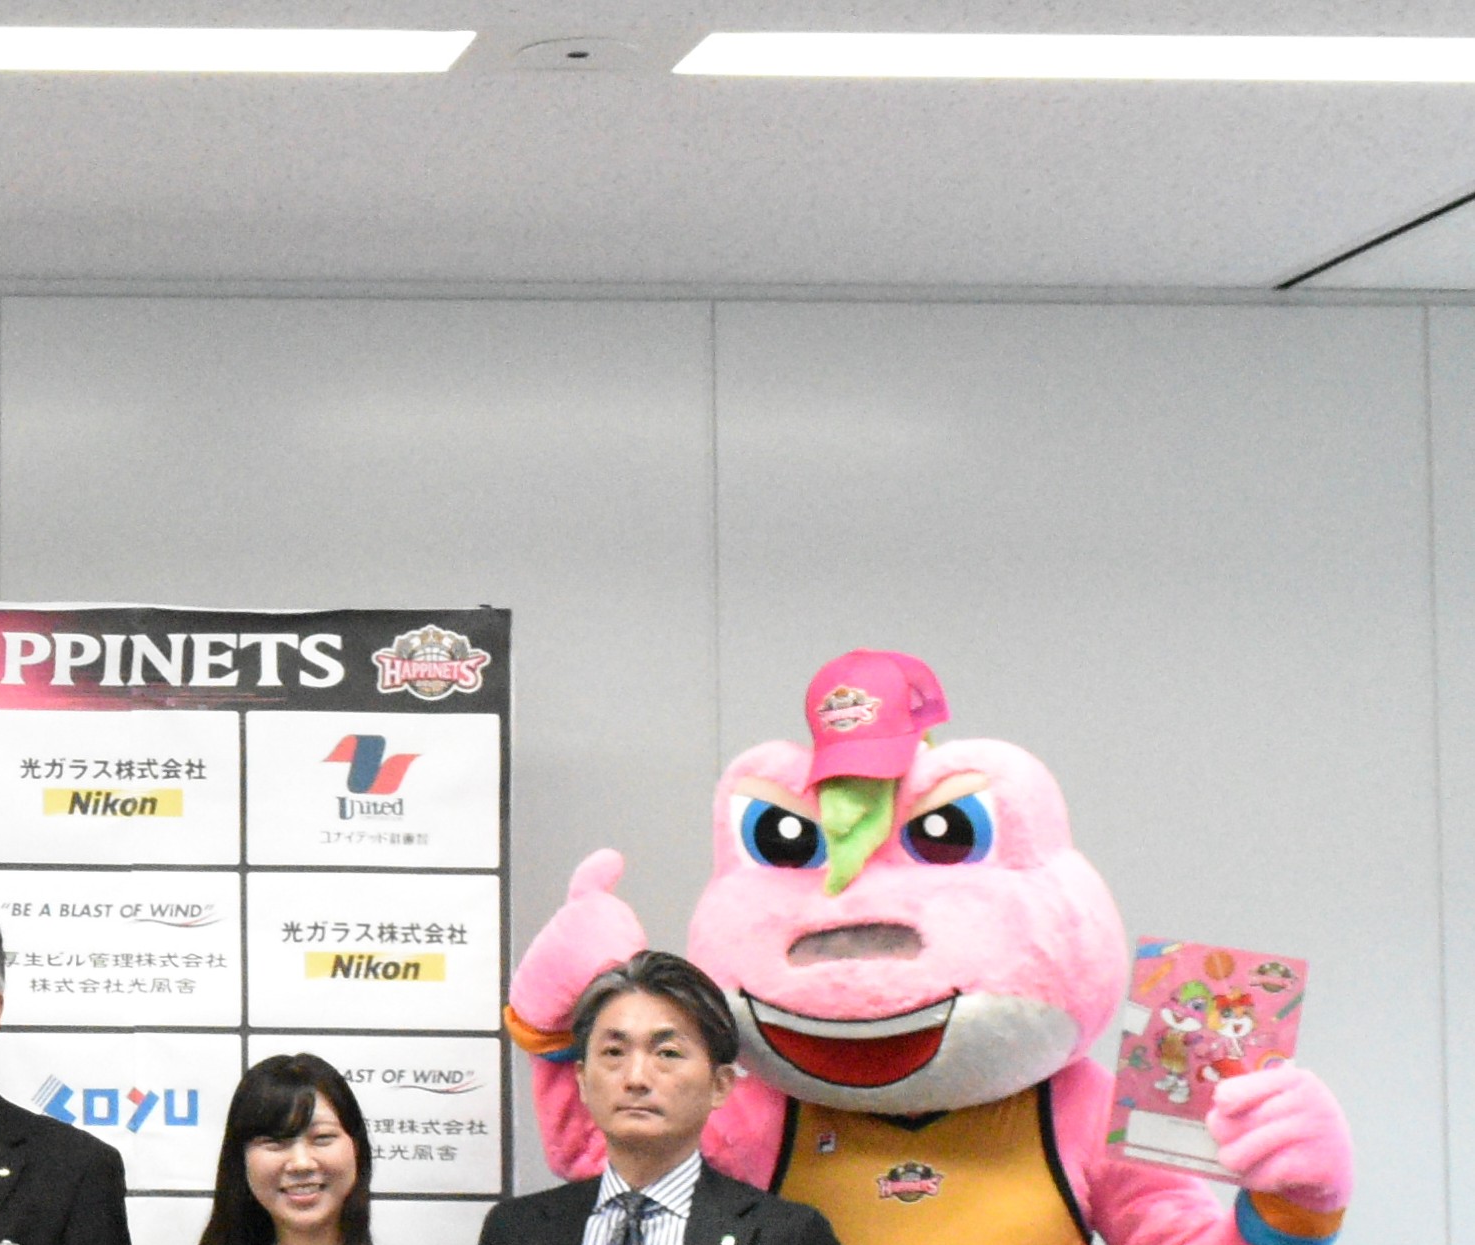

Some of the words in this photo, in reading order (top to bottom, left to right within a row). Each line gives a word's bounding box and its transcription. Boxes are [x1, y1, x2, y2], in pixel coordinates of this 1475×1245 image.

[376, 654, 488, 689] HAPPINETS
[20, 757, 208, 781] 光ガラス株式会社
[67, 791, 158, 816] Nikon
[335, 796, 404, 820] United
[39, 903, 52, 917] A
[59, 903, 113, 918] BLAST
[120, 904, 143, 918] OF
[281, 921, 469, 945] 光ガラス株式会社
[330, 955, 421, 980] Nikon
[30, 978, 196, 995] 株式会社光風舎
[381, 1069, 407, 1084] OF
